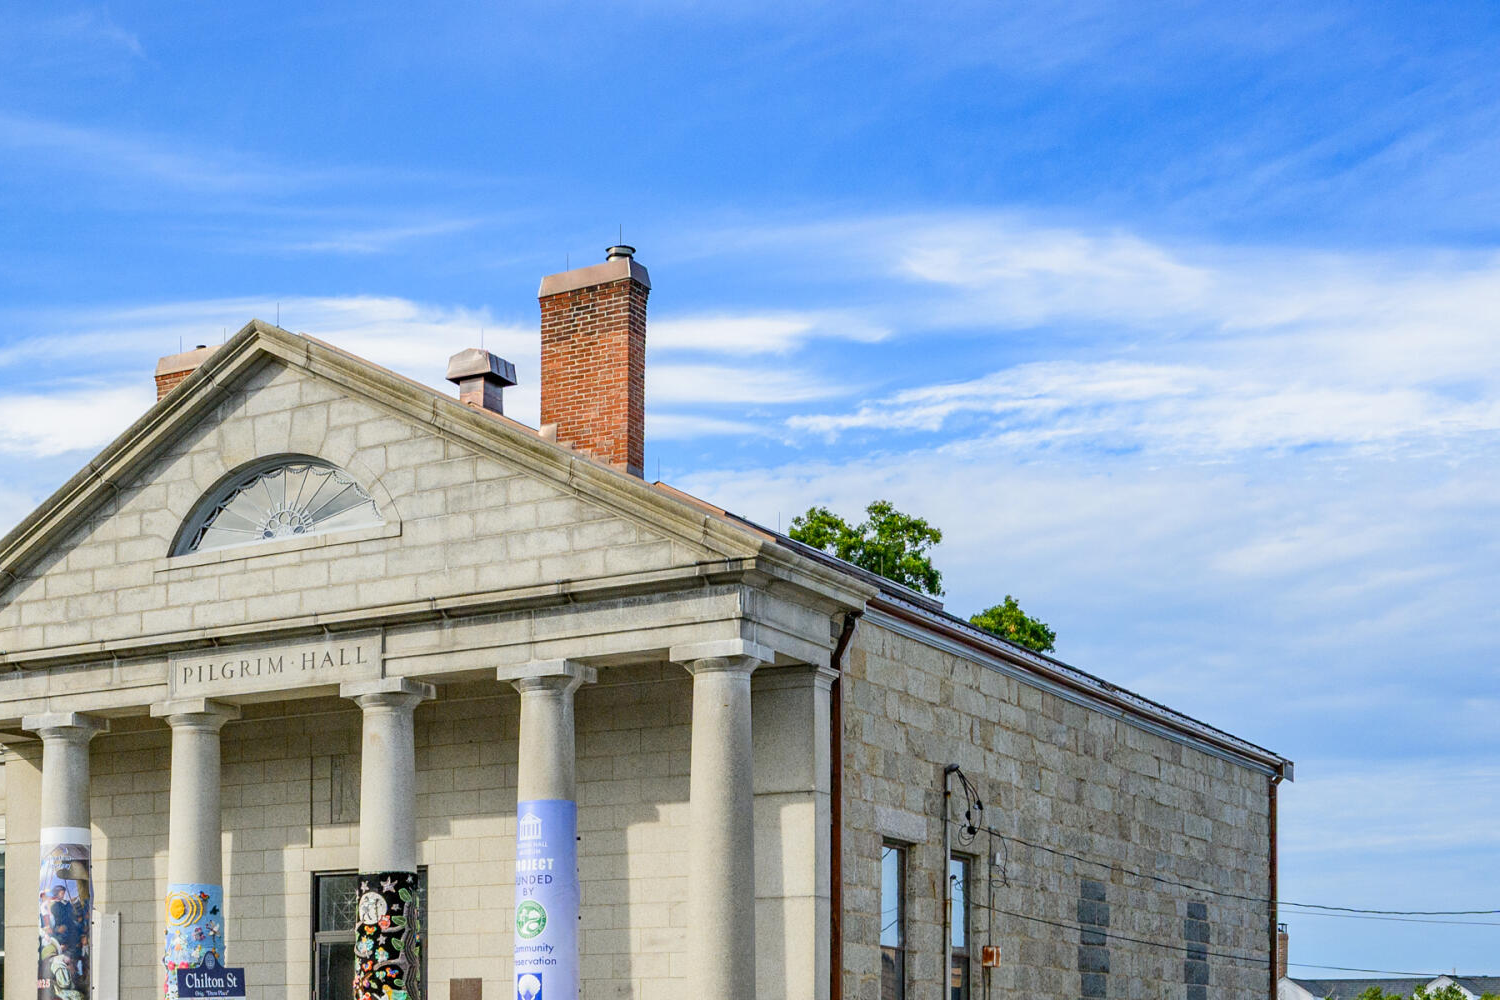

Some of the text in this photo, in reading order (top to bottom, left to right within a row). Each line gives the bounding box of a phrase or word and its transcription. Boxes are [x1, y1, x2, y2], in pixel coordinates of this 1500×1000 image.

[182, 646, 368, 684] PILGRIM HALL
[516, 858, 554, 872] OJECT
[516, 874, 553, 886] UNDED
[523, 887, 534, 896] BY
[185, 972, 238, 989] Chilton St
